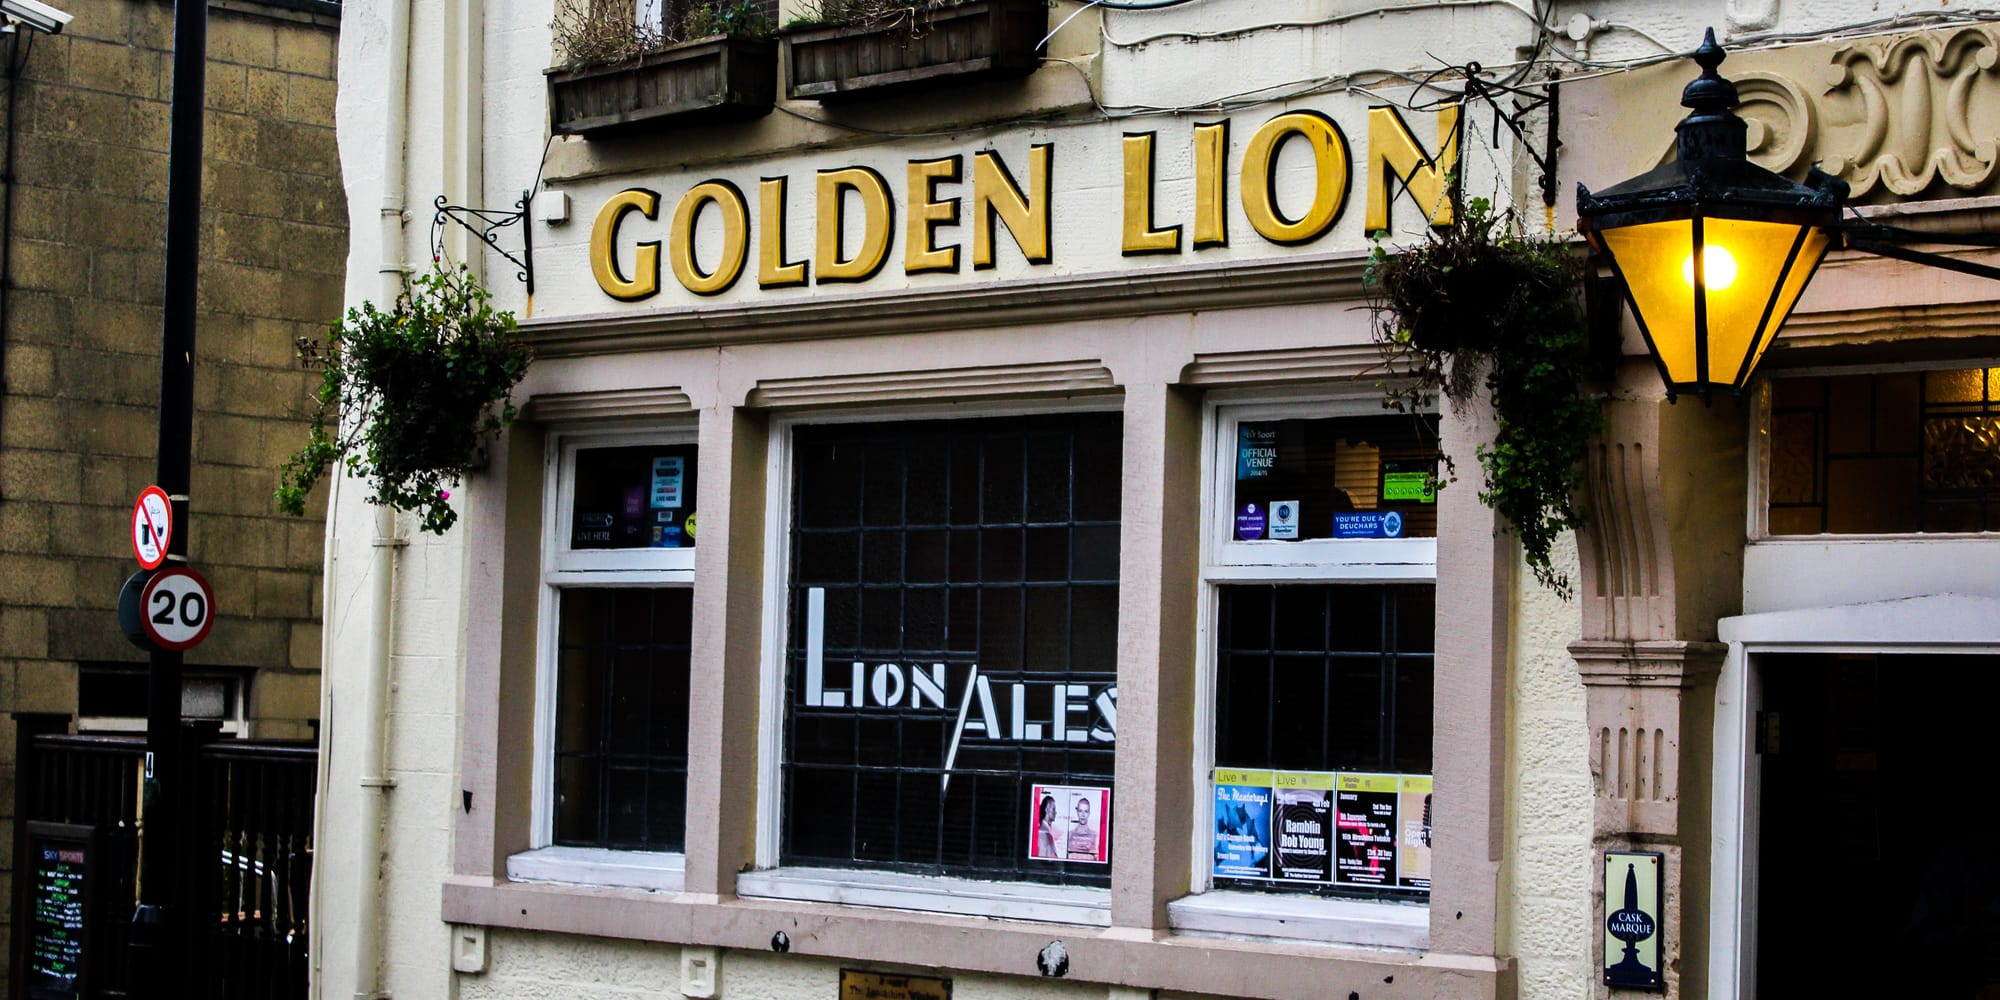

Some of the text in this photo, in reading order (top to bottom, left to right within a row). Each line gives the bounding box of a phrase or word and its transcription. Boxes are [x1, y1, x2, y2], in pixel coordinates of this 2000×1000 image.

[589, 98, 1462, 302] GOLDEN LION
[1242, 447, 1278, 458] OFFICIAL
[1246, 458, 1273, 468] VENUE
[152, 589, 206, 628] 20
[805, 587, 1117, 793] LION ALES
[1218, 771, 1237, 782] Live
[1277, 776, 1297, 785] Live
[1285, 819, 1321, 834] Ramblin
[1281, 834, 1325, 850] Rob Young
[1404, 838, 1427, 848] Night
[43, 850, 84, 864] SKY SPORTS
[1618, 912, 1643, 923] CASK
[1611, 922, 1652, 935] MARQUE
